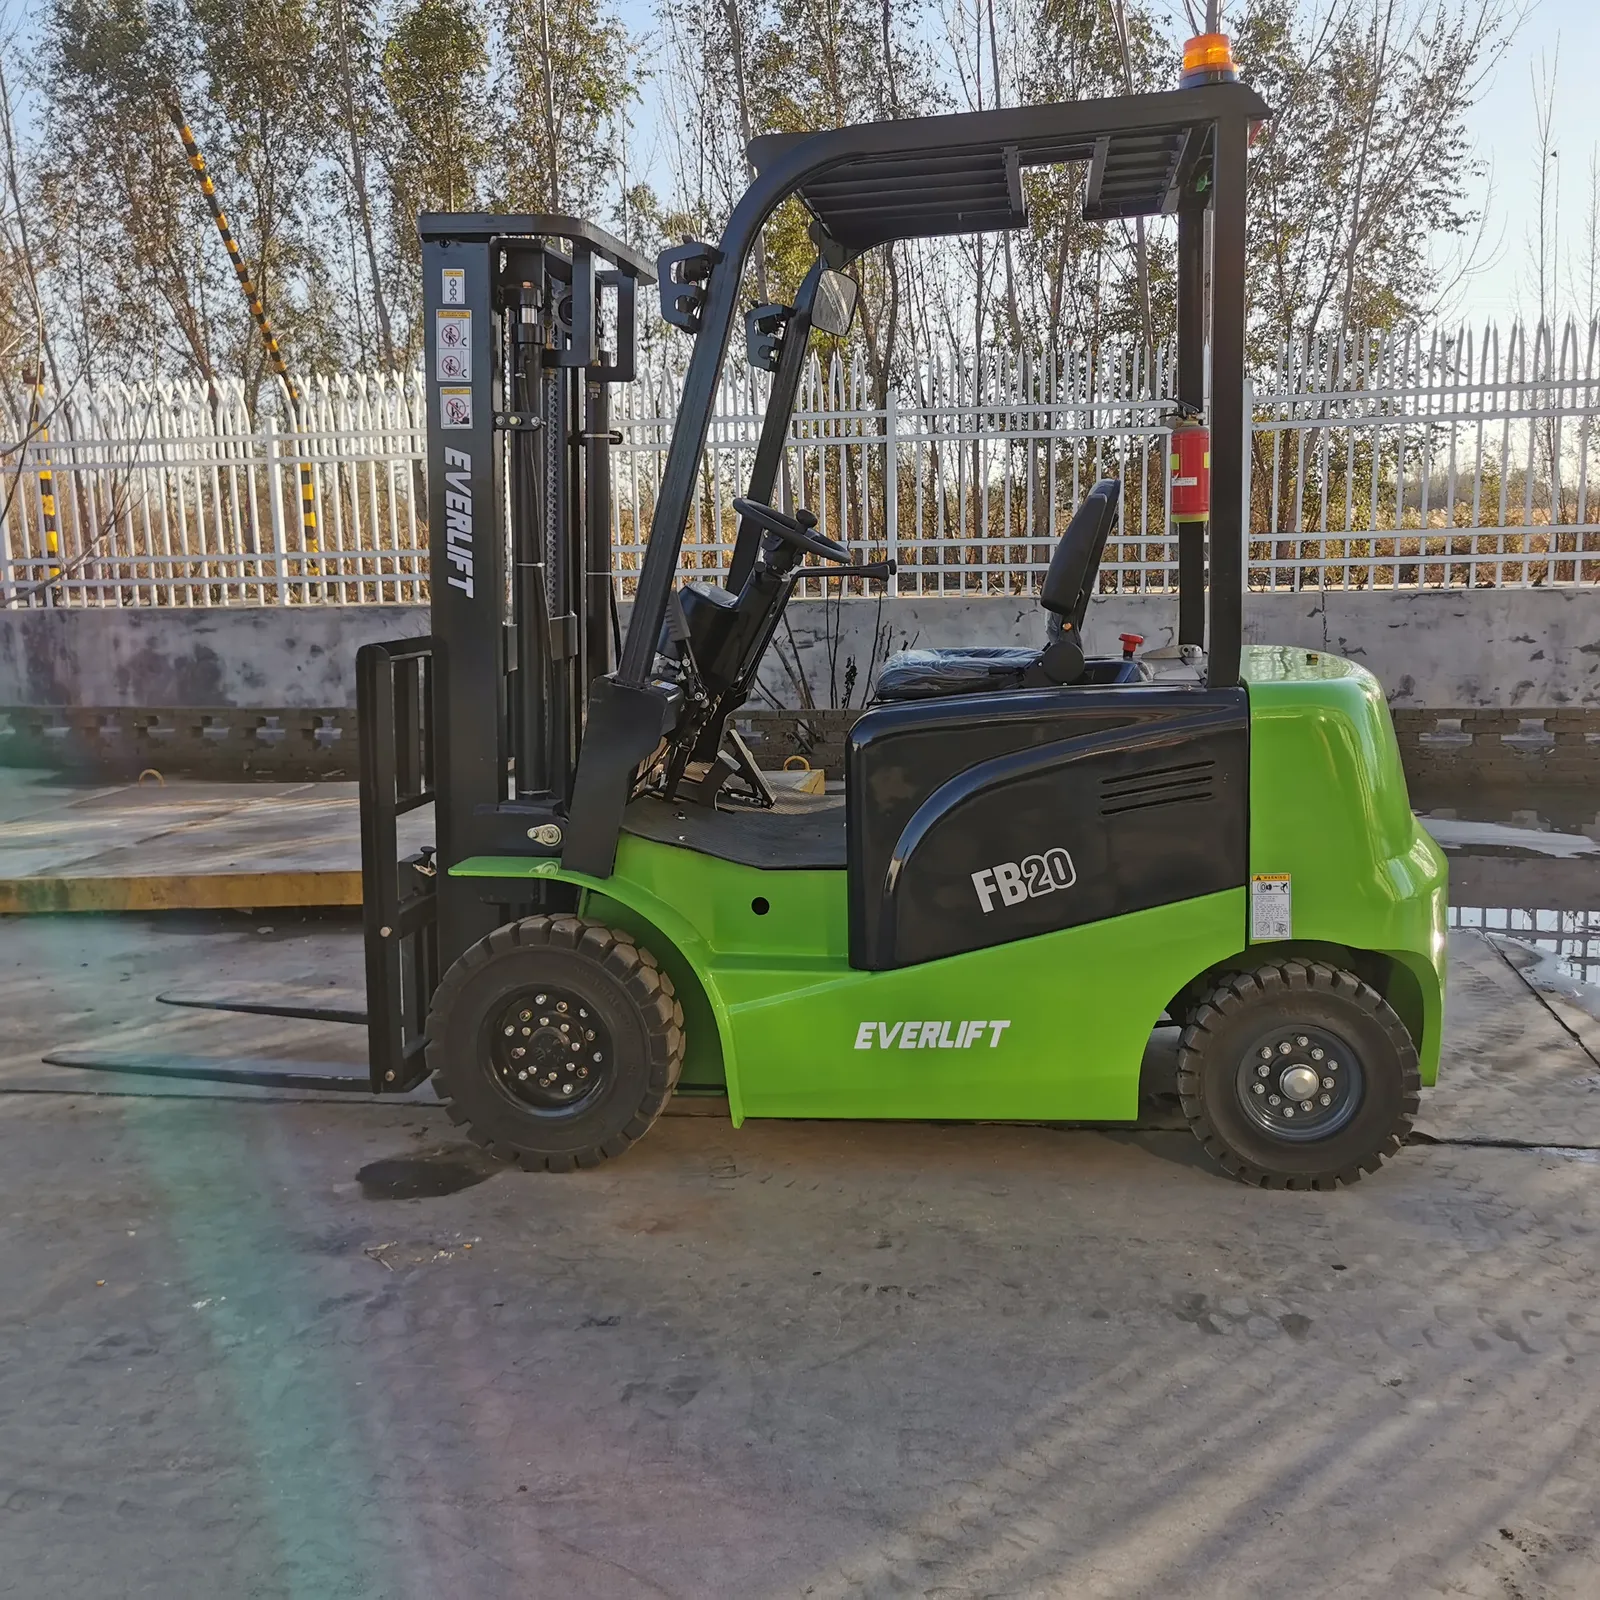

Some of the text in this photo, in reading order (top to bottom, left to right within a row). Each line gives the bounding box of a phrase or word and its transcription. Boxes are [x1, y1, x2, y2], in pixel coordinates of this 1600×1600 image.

[444, 446, 474, 599] EVERLIFT
[970, 847, 1077, 913] FB20
[853, 1020, 1011, 1049] EVERLIFT
